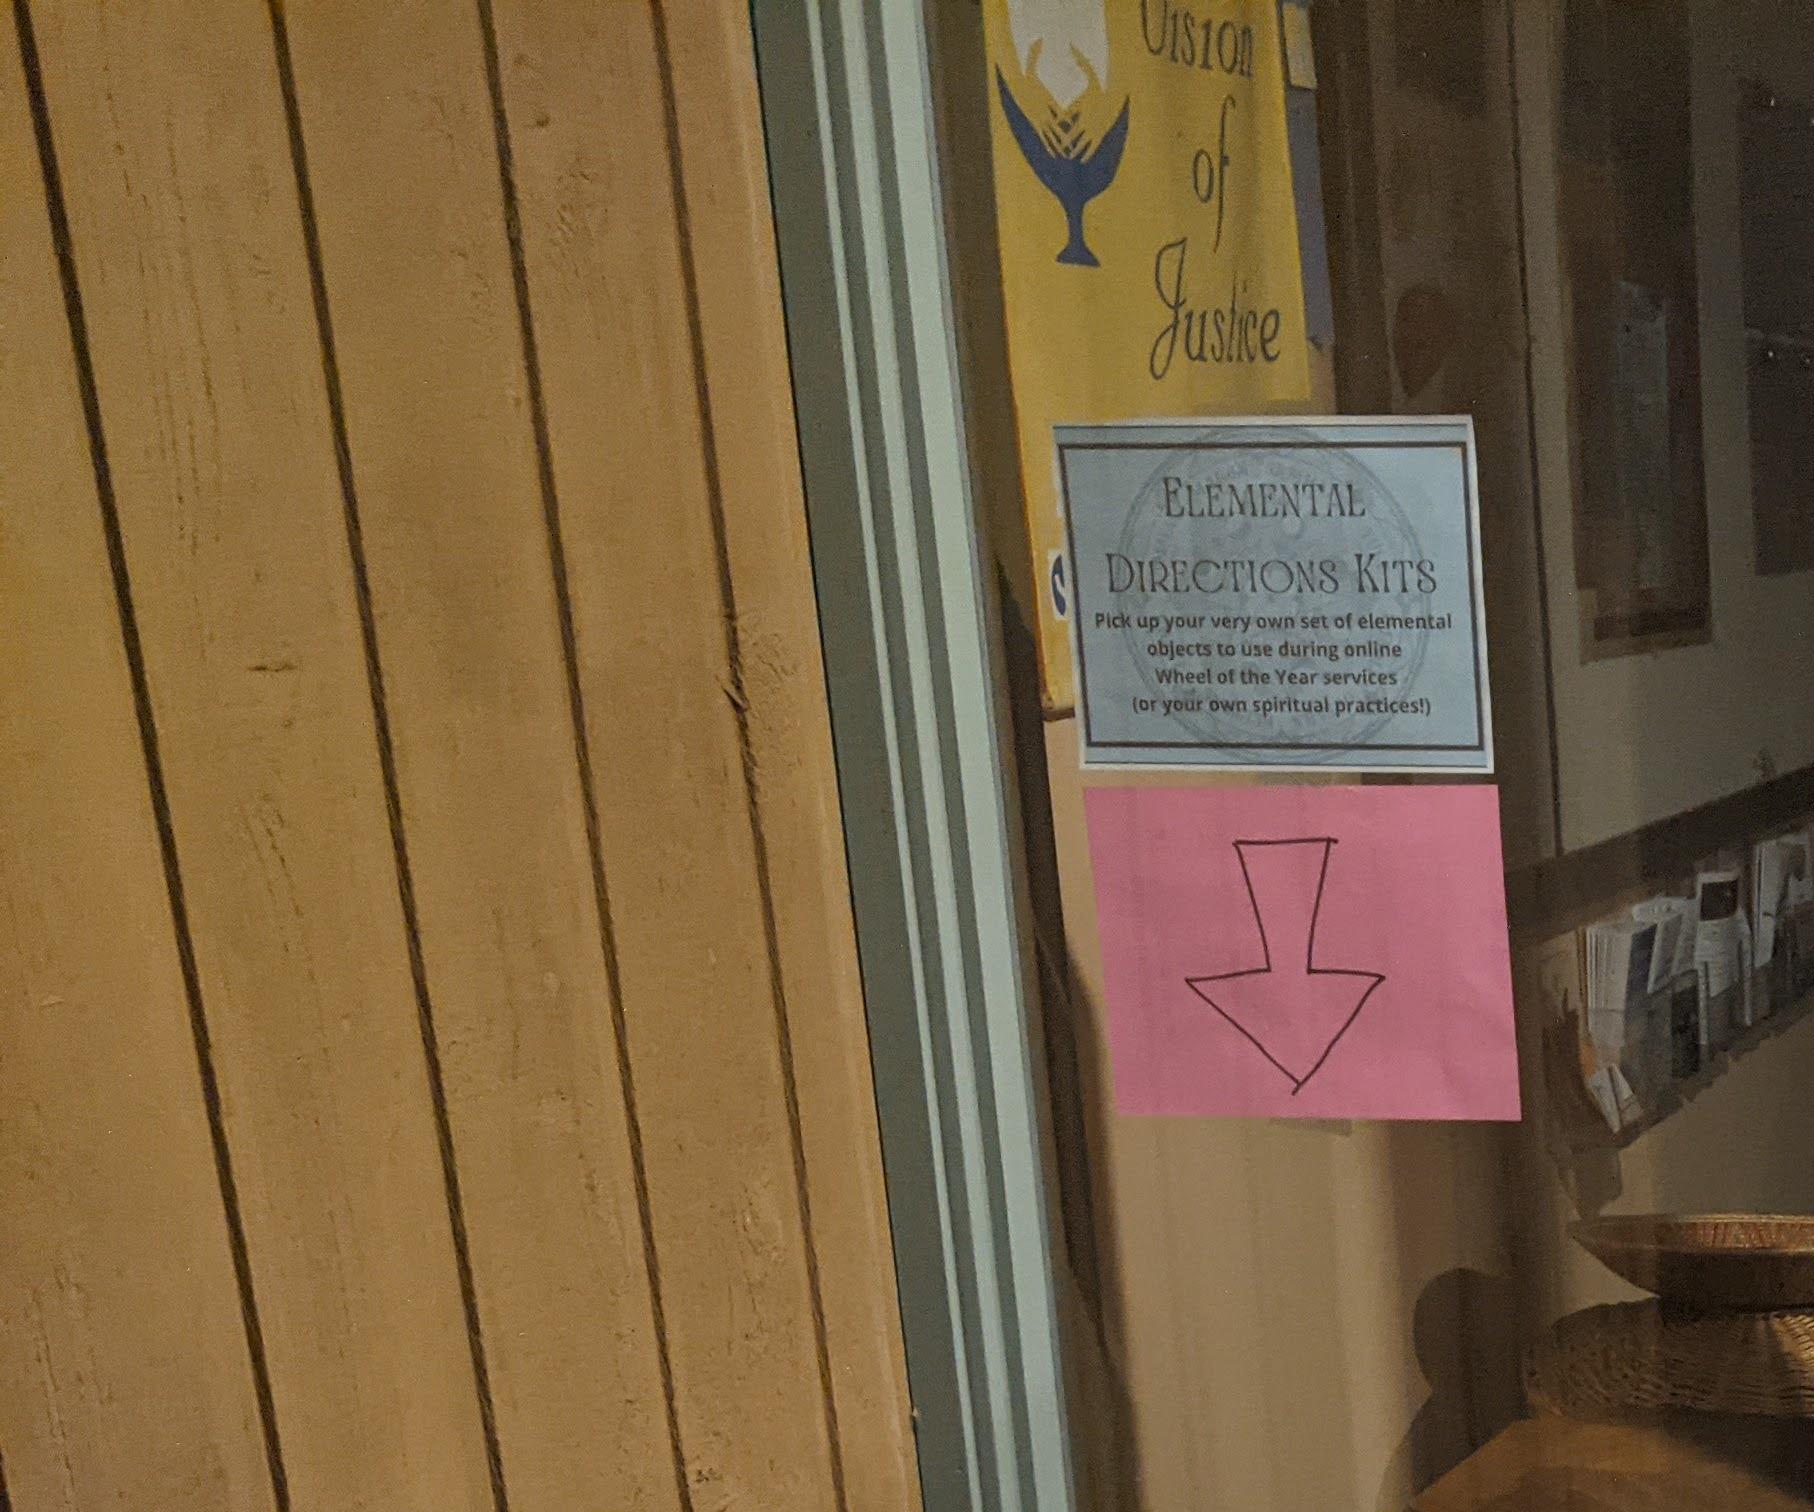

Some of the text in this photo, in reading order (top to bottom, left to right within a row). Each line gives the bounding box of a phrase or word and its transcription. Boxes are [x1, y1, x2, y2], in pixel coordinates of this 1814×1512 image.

[1193, 94, 1236, 254] of
[1150, 237, 1280, 380] Justice
[1094, 611, 1452, 637] Pick up your very own set of elemental
[1147, 641, 1401, 661] objects to use during online
[1154, 663, 1398, 686] Wheel of the Year services
[1132, 696, 1431, 717] (or your own spiritual practices!)
